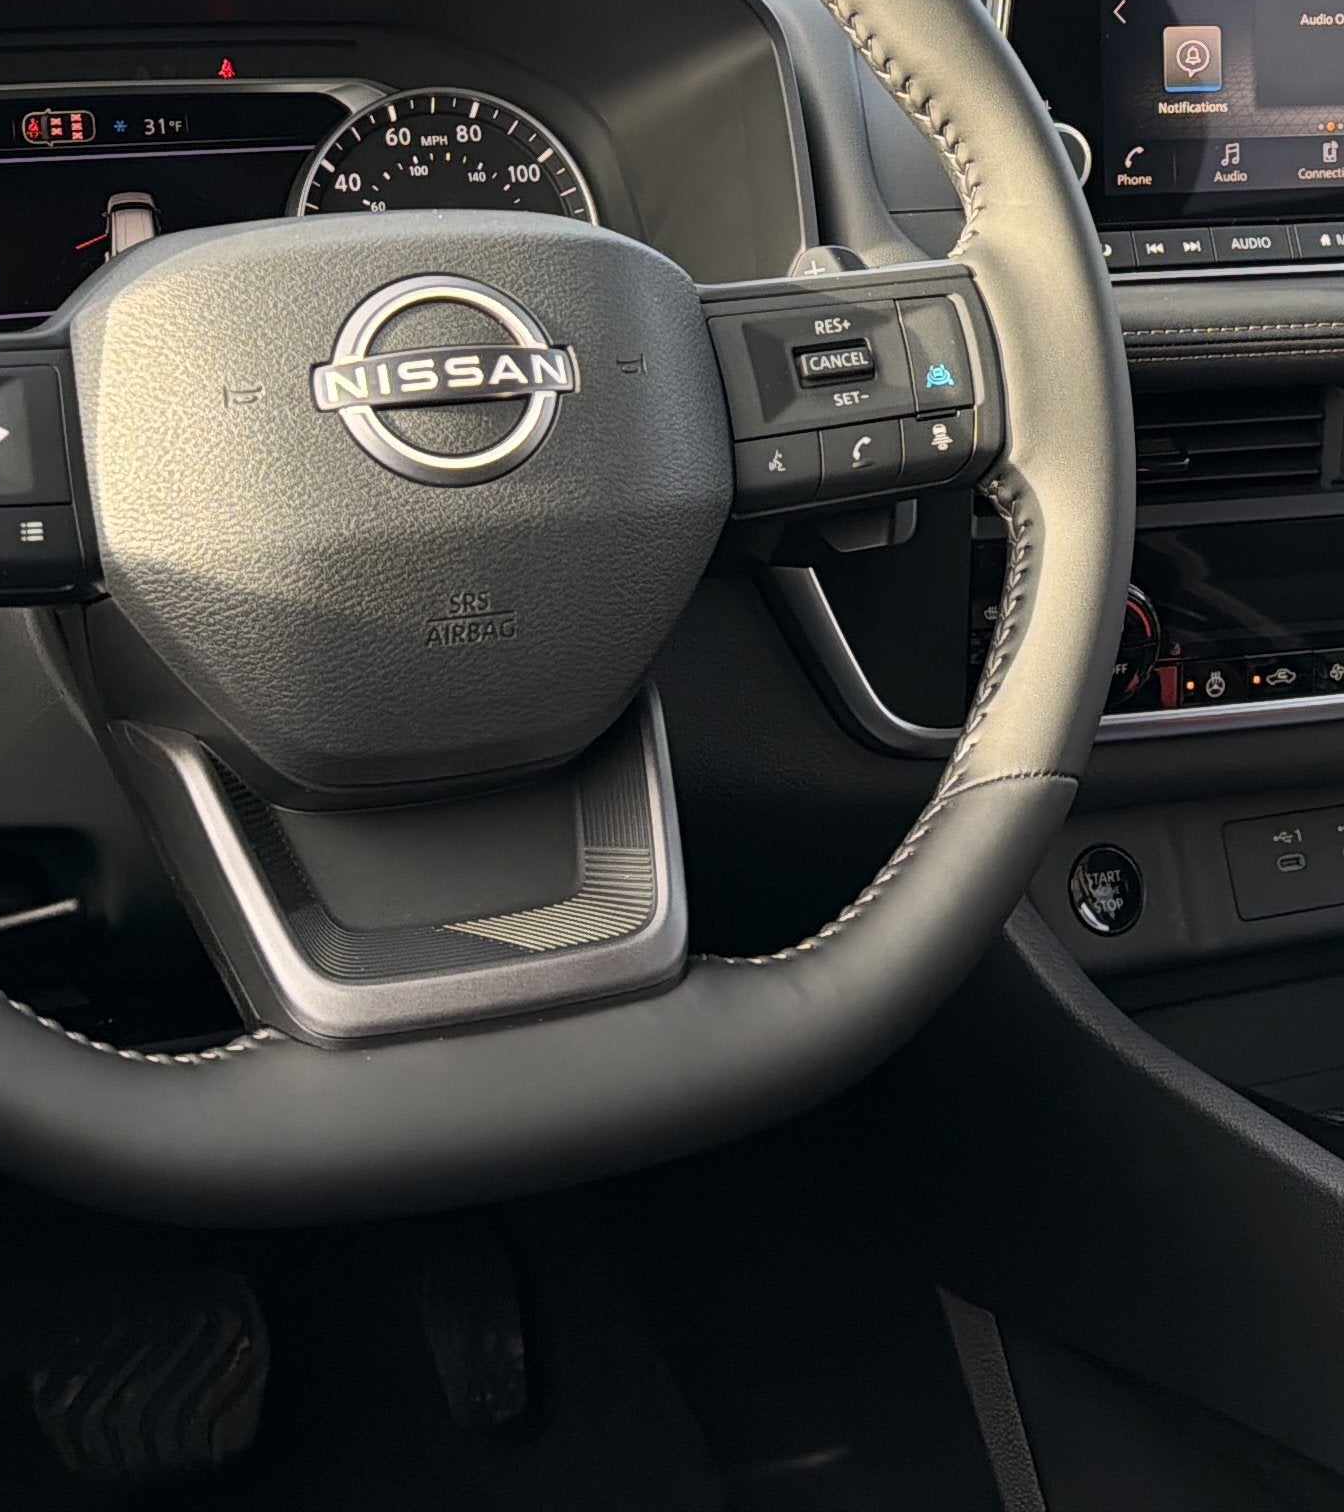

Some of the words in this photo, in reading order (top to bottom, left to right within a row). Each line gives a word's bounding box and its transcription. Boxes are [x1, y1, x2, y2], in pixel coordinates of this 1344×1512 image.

[1299, 13, 1333, 26] Audio
[1158, 101, 1229, 115] Notifications
[385, 126, 411, 146] 60
[420, 134, 449, 148] MPH
[456, 124, 482, 143] 80
[409, 165, 429, 177] 100
[467, 171, 487, 183] 140
[507, 163, 541, 183] 100
[1213, 170, 1248, 183] Audio
[334, 172, 362, 192] 40
[1117, 174, 1153, 186] Phone
[370, 201, 386, 213] 60
[1231, 236, 1272, 251] AUDIO
[814, 317, 852, 336] RES+
[809, 351, 869, 371] CANCEL
[323, 353, 568, 404] NISSAN
[448, 591, 490, 615] SRS
[425, 619, 518, 649] AIRBAG
[1114, 663, 1128, 675] FF
[1094, 898, 1124, 914] STOP
